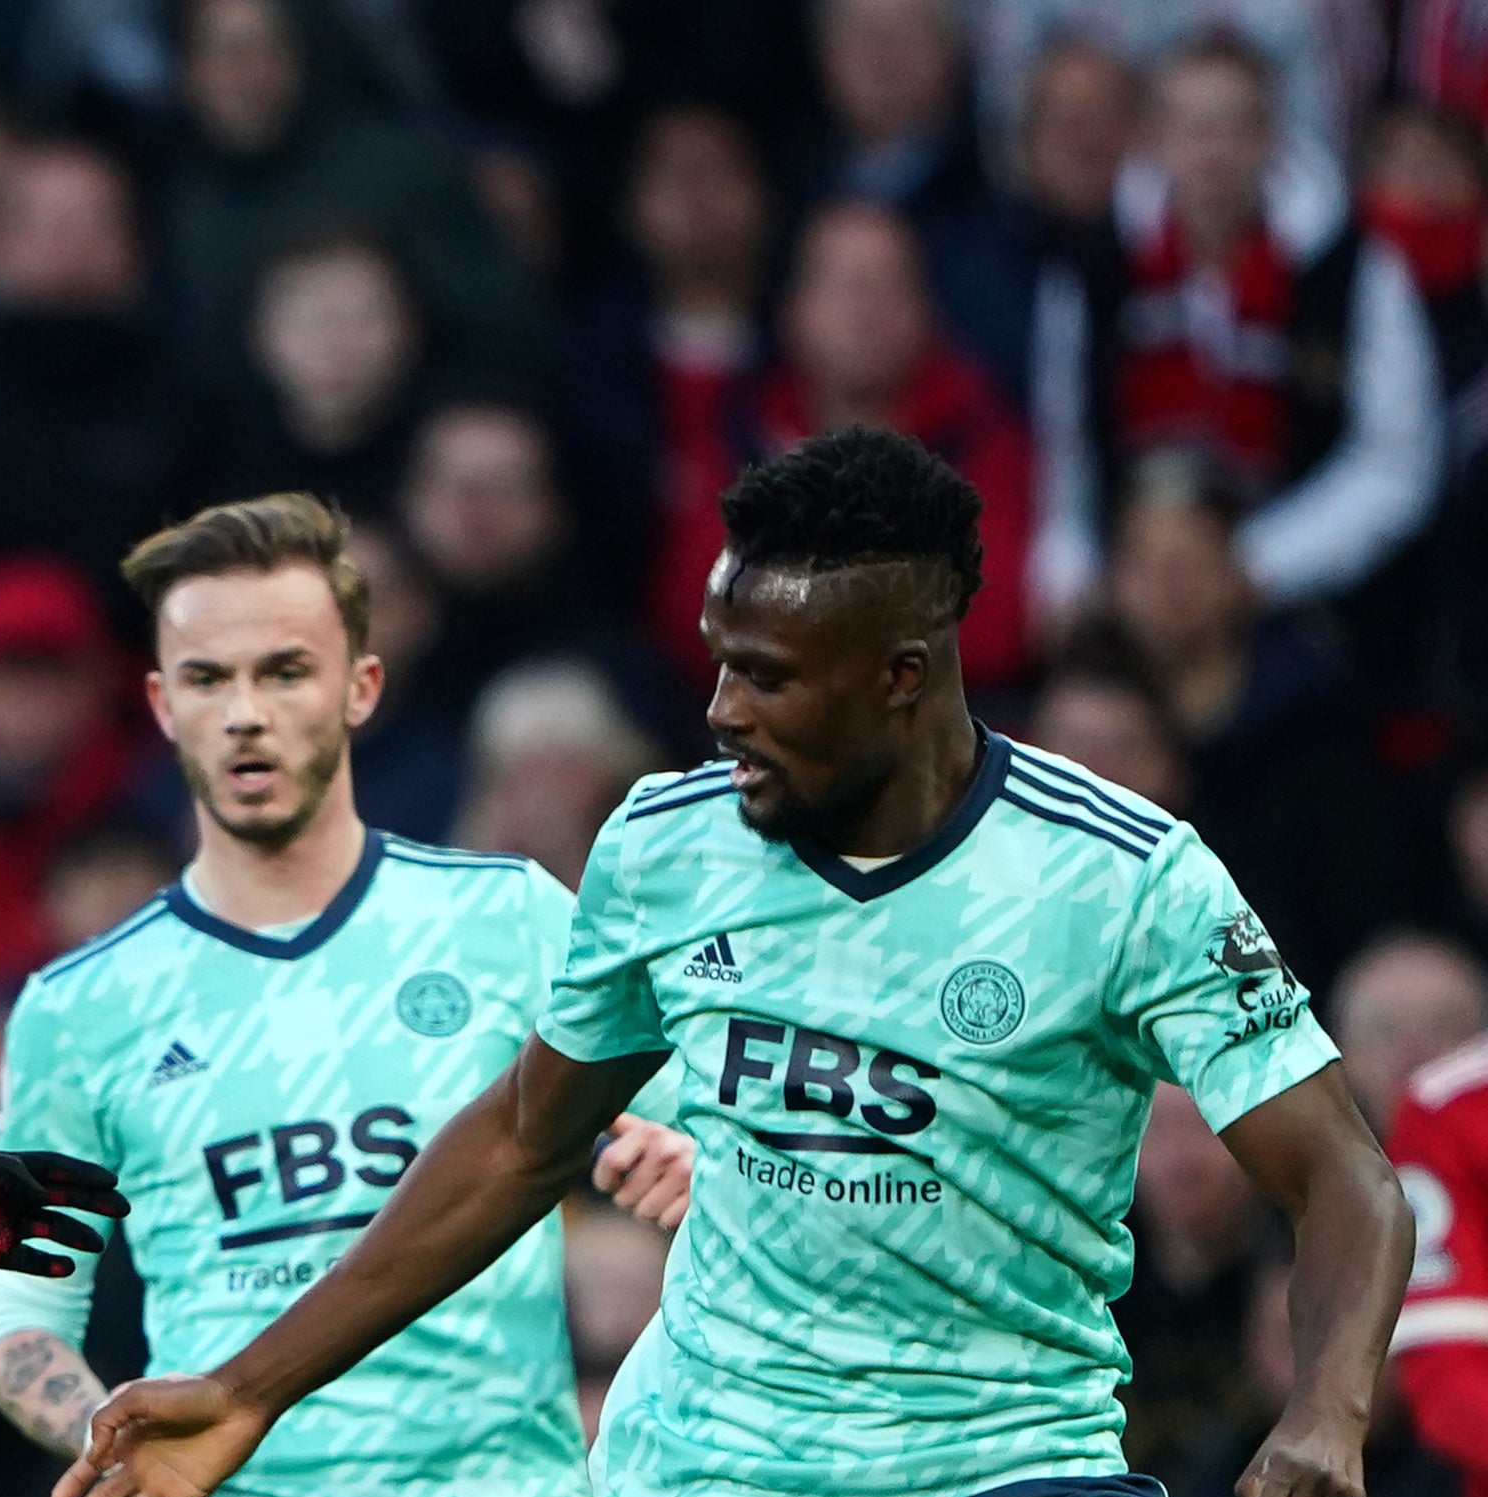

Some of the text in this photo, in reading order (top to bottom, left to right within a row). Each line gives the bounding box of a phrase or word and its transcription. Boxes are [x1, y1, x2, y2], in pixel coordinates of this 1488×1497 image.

[683, 962, 743, 984] adidas
[718, 1016, 941, 1136] FBS
[203, 1105, 419, 1220] FBS
[736, 1146, 943, 1204] trade online
[228, 1255, 315, 1292] trade
